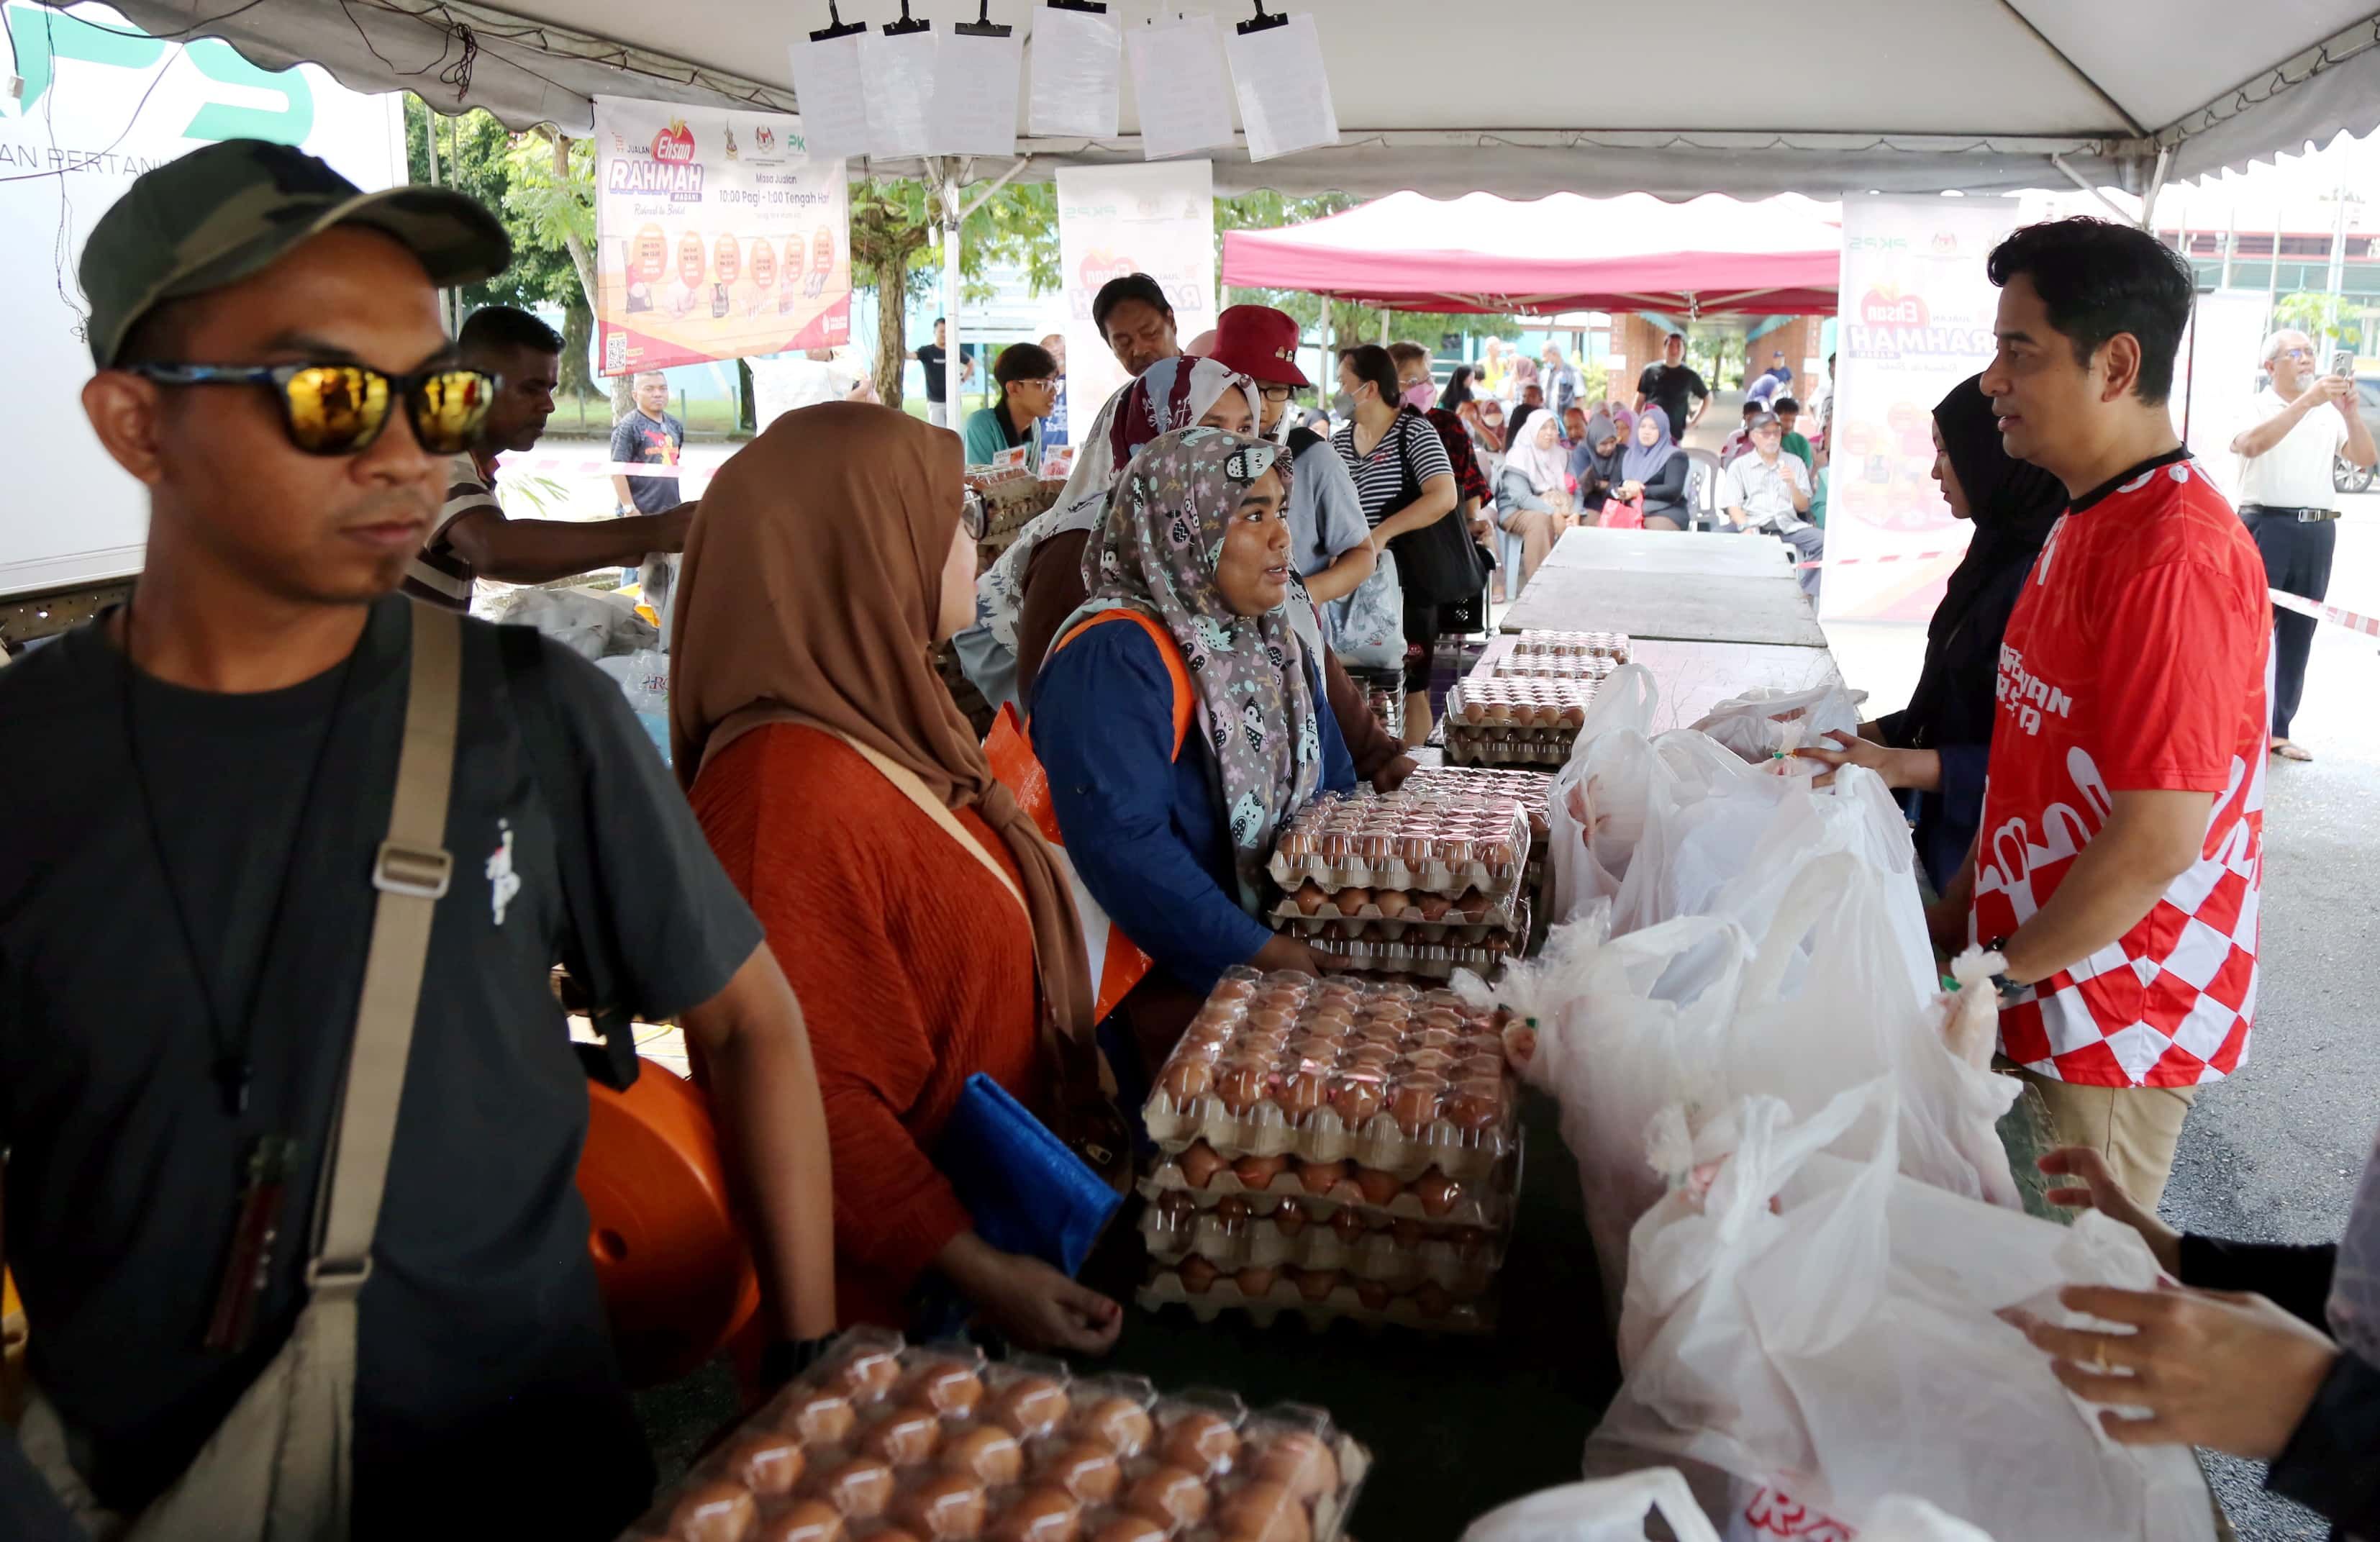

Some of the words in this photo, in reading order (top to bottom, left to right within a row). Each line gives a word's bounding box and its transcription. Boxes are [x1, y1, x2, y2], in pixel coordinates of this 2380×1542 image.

[627, 145, 650, 154] JUALAN
[658, 135, 691, 160] Ehsan
[788, 135, 806, 152] PK
[609, 159, 704, 193] RAHMAH
[755, 173, 773, 184] Masa
[775, 175, 796, 185] Jualan
[719, 190, 740, 202] 10:00
[742, 191, 760, 207] Pagi
[768, 191, 783, 204] 1:00
[785, 192, 816, 207] Tengah
